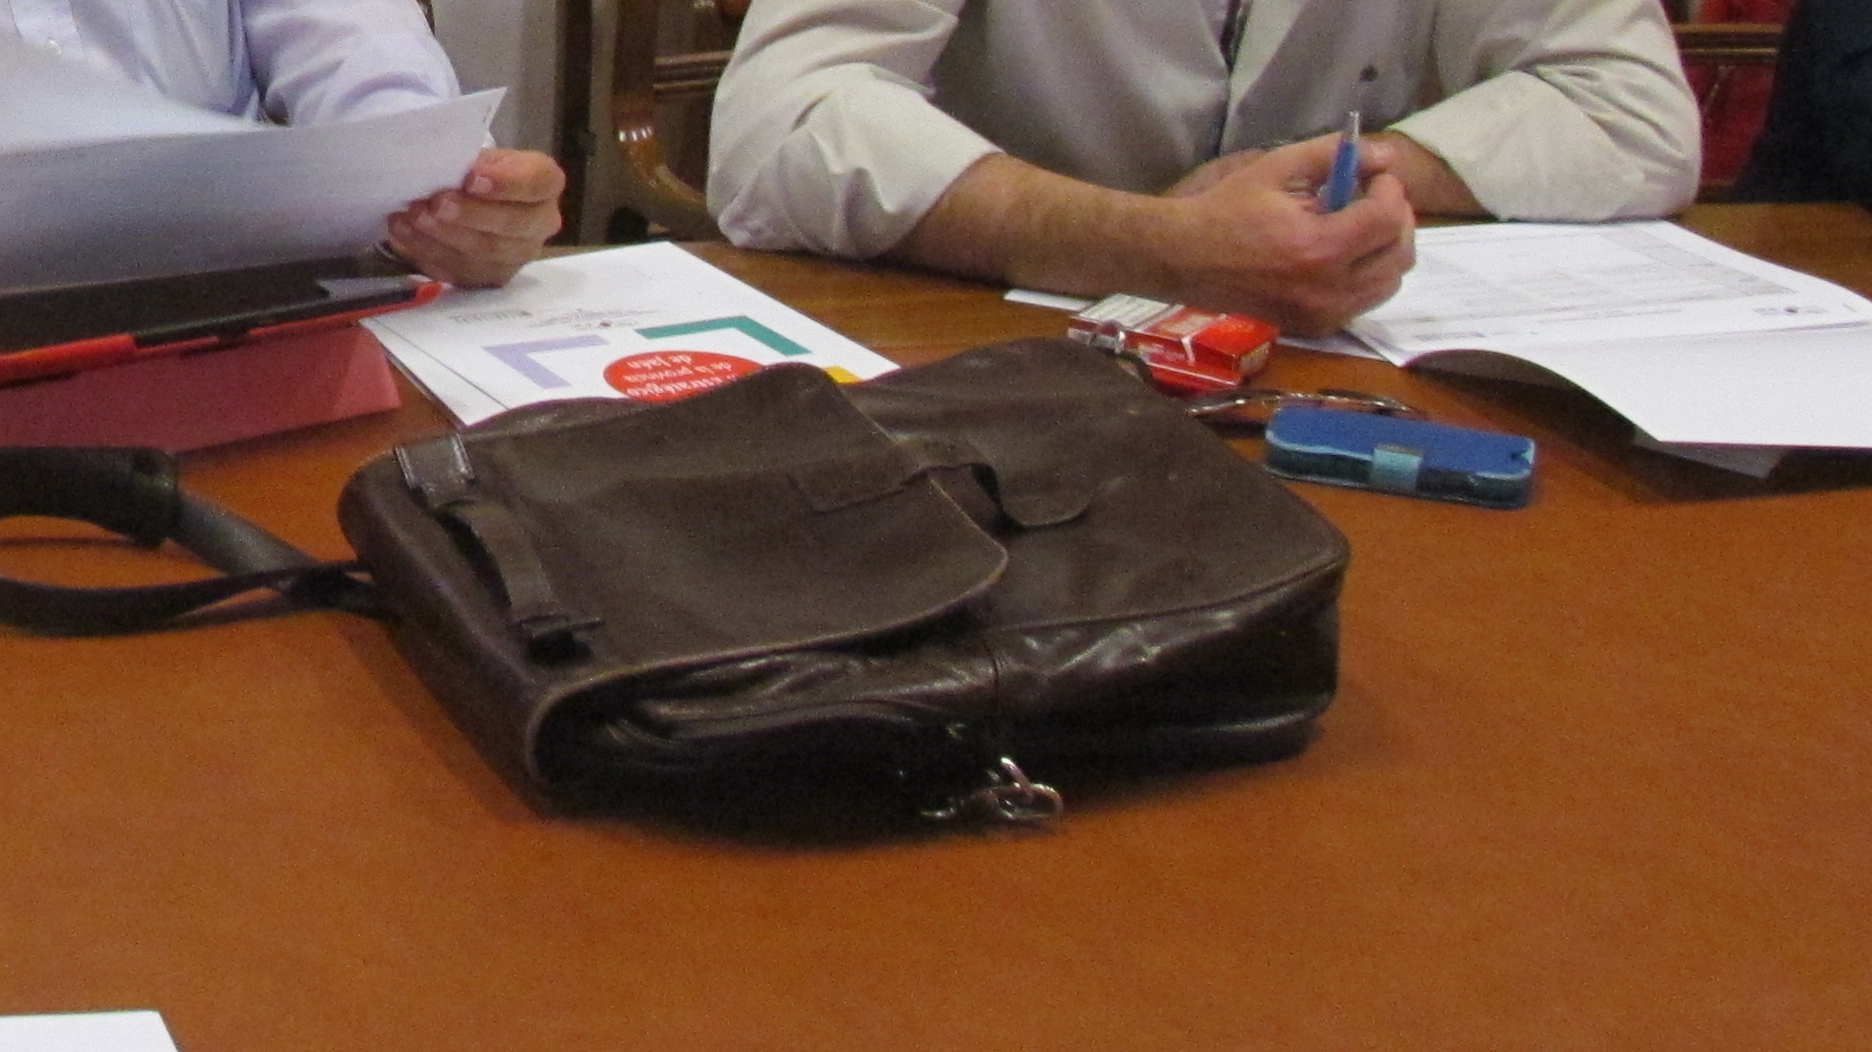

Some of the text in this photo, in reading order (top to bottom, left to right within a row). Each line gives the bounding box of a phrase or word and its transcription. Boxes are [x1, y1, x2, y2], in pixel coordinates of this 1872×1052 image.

[626, 354, 693, 370] de Jaén
[623, 361, 732, 384] de la provincia
